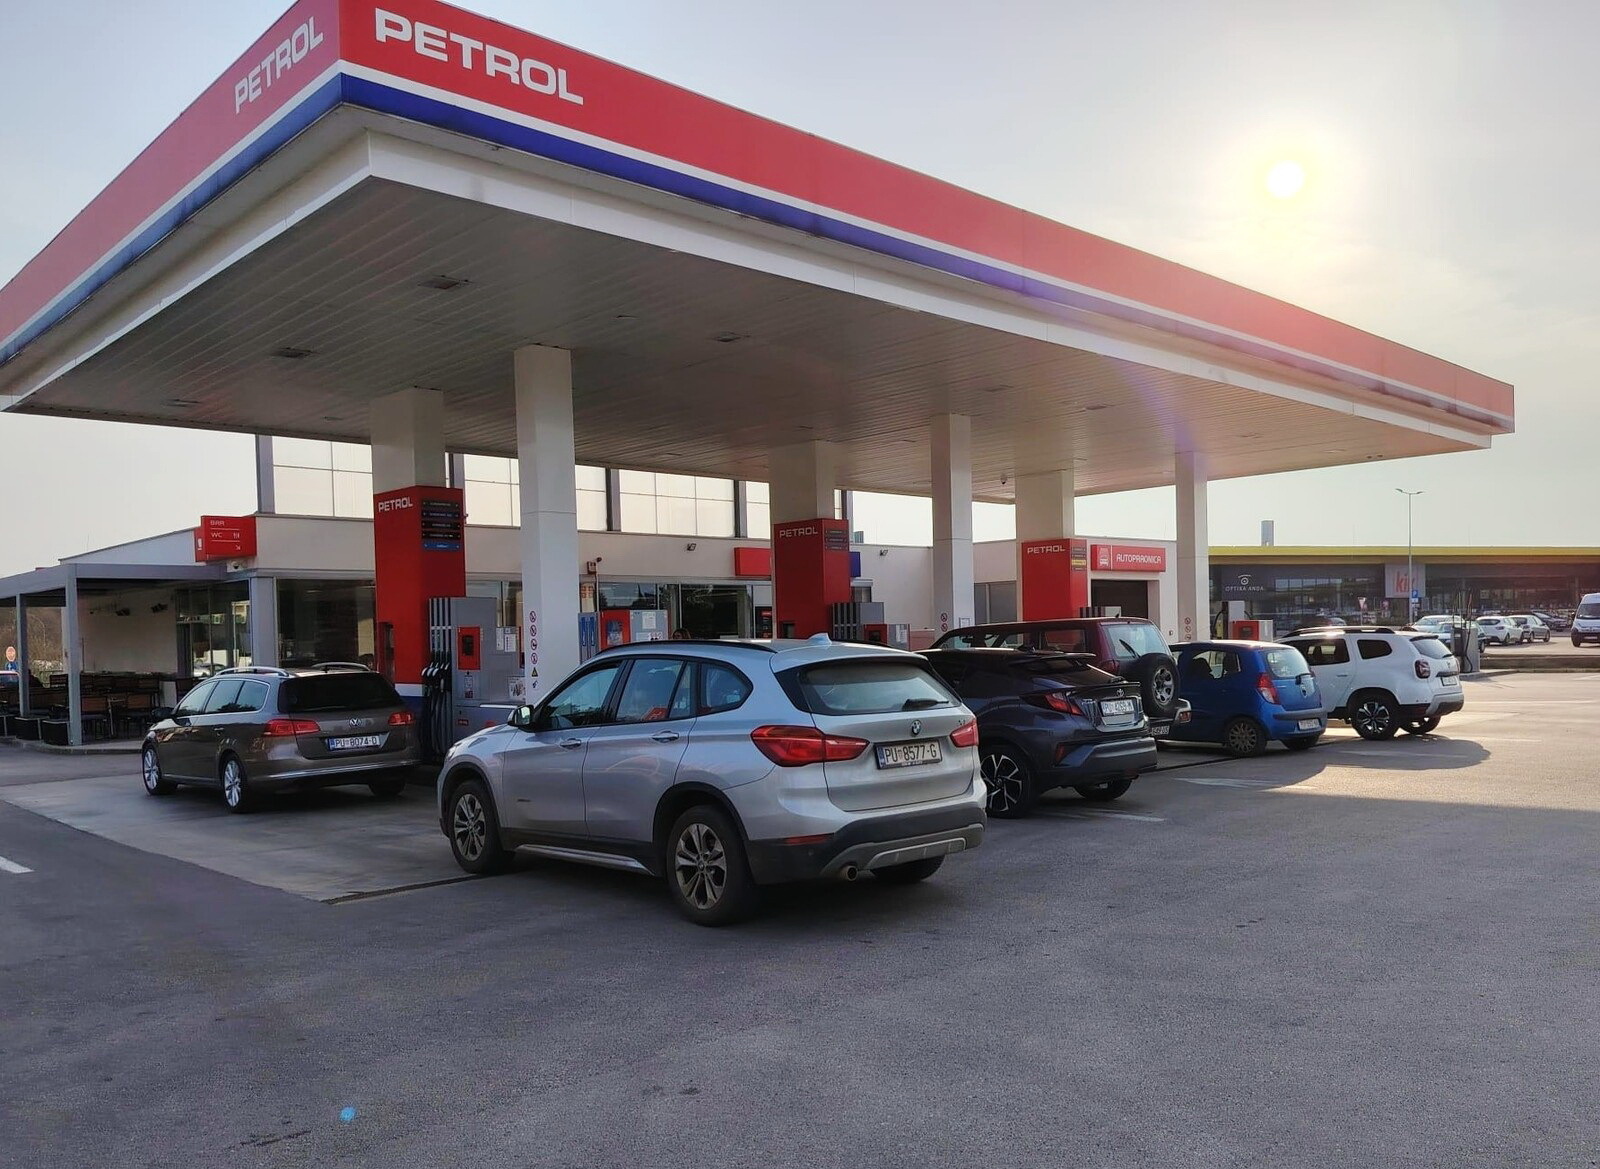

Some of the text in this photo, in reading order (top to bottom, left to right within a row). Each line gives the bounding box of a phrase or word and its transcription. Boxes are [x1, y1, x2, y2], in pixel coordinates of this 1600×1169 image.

[235, 16, 324, 114] PETROL
[375, 7, 584, 106] PETROL
[378, 497, 414, 513] PETROL
[779, 526, 819, 539] PETROL
[1027, 545, 1066, 555] PETROL
[884, 743, 937, 763] PU 8577-G
